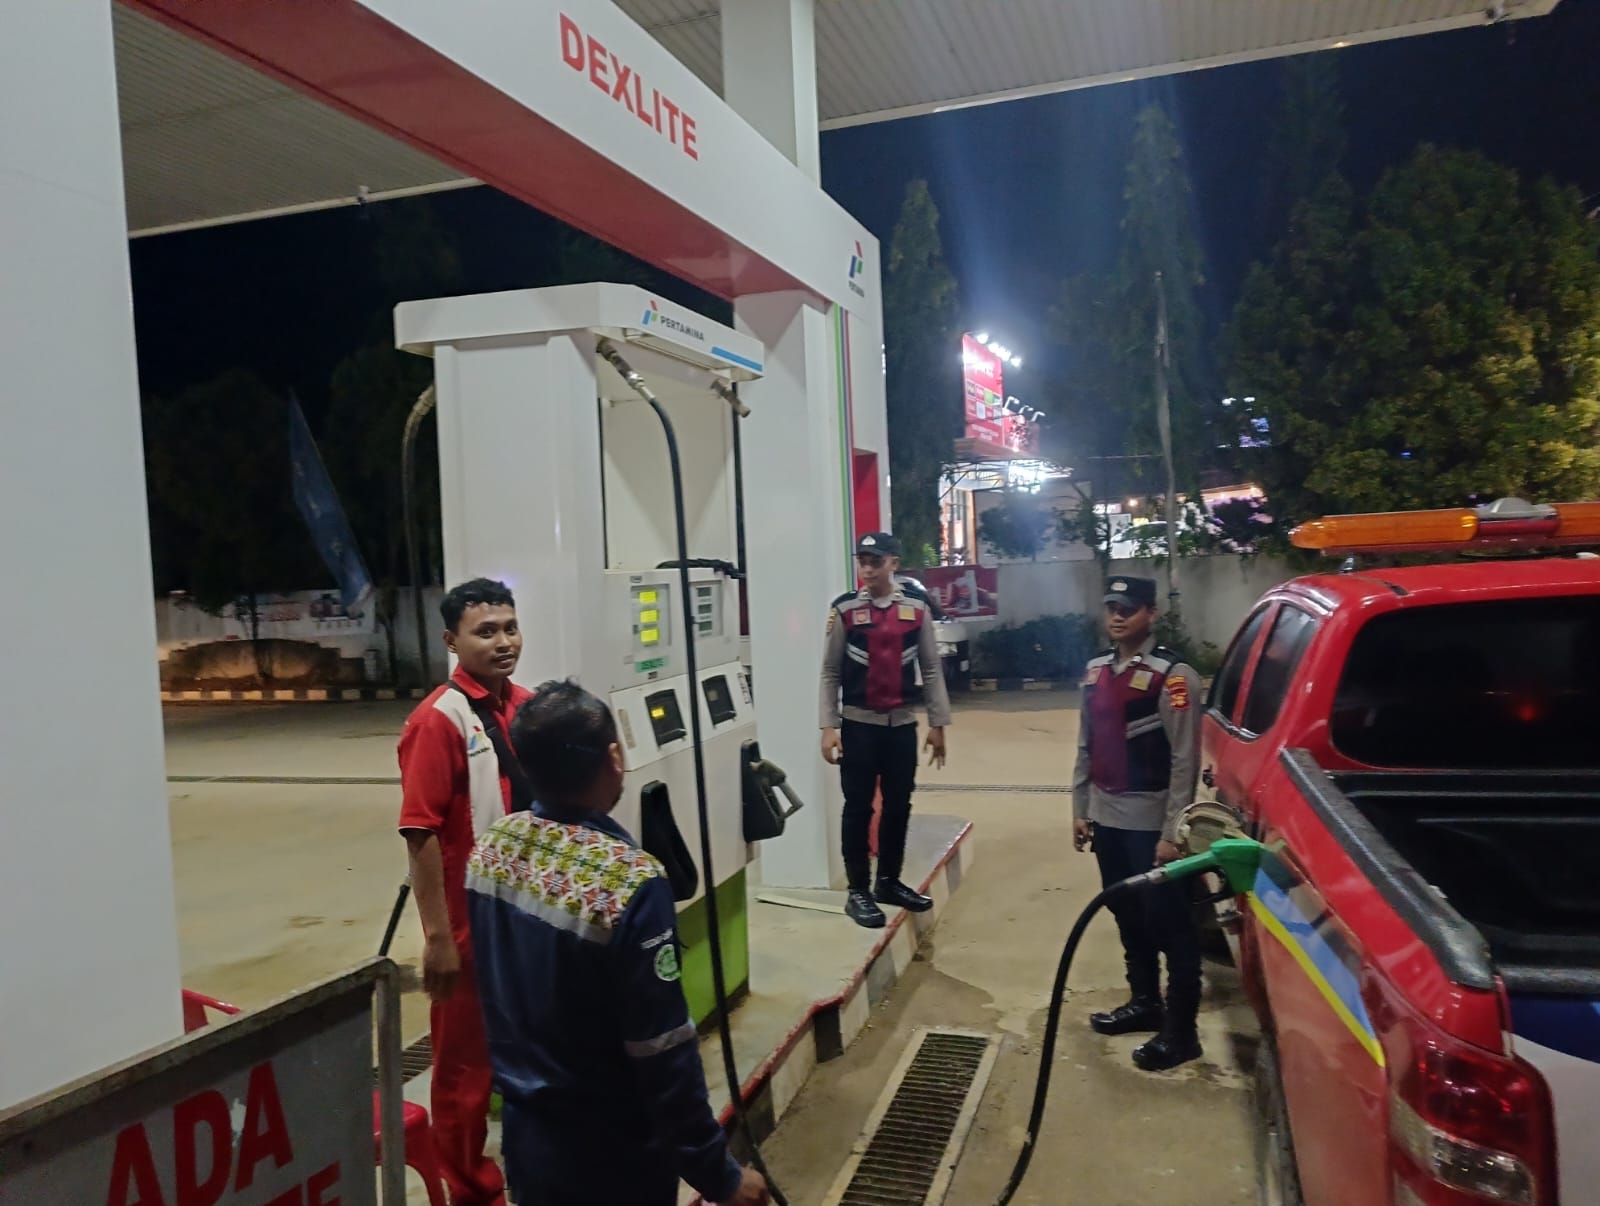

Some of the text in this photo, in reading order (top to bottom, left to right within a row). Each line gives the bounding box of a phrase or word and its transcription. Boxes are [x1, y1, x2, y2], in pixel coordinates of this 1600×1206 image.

[559, 12, 699, 161] DEXLITE
[660, 315, 704, 341] PERTAMINA
[106, 1060, 294, 1206] ADA
